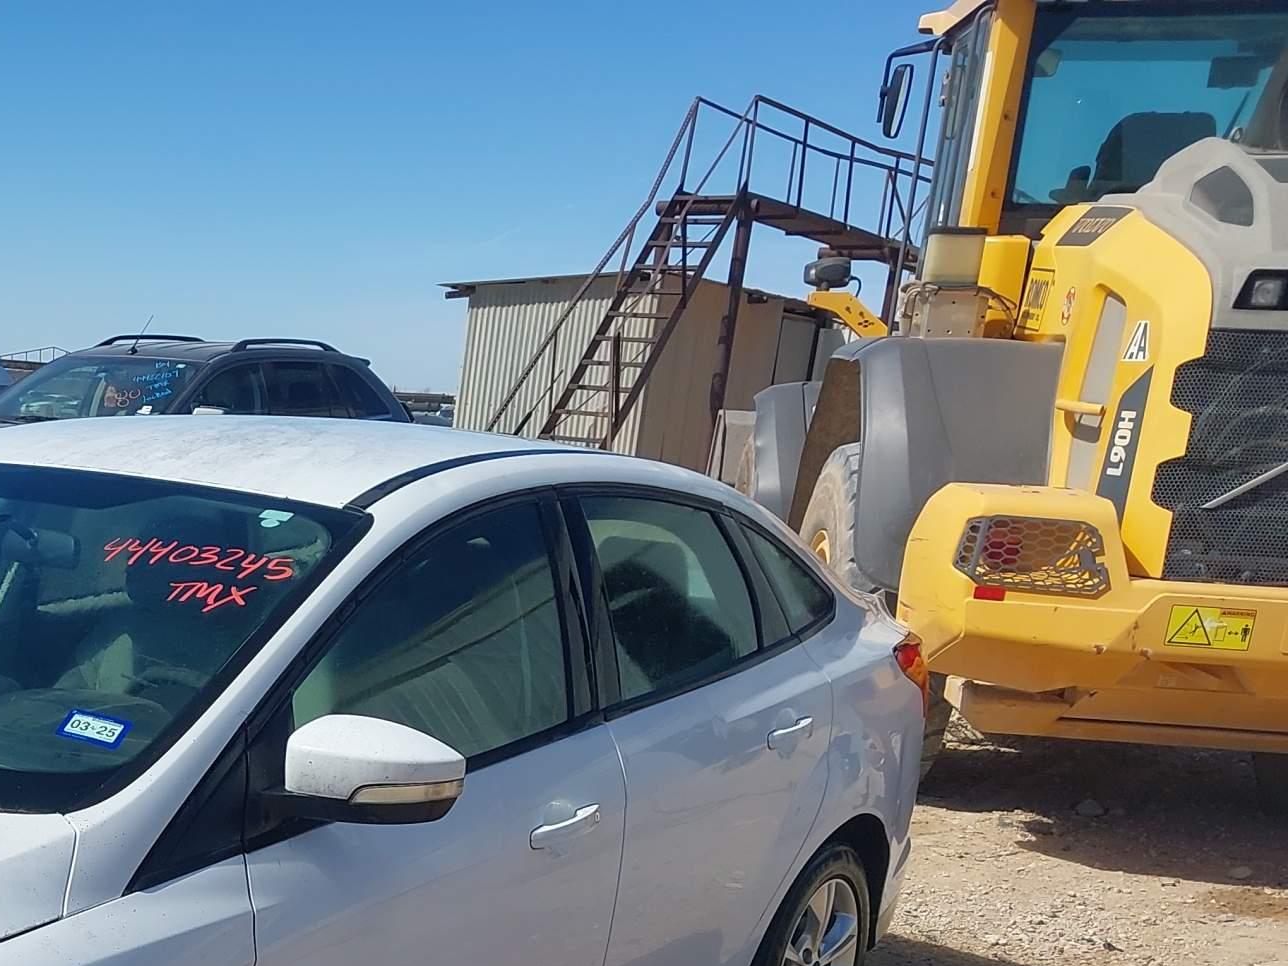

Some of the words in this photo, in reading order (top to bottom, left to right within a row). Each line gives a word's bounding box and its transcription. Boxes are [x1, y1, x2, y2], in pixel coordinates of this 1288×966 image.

[1106, 410, 1137, 476] L90H
[103, 537, 295, 580] 44403245
[166, 582, 258, 613] TMX
